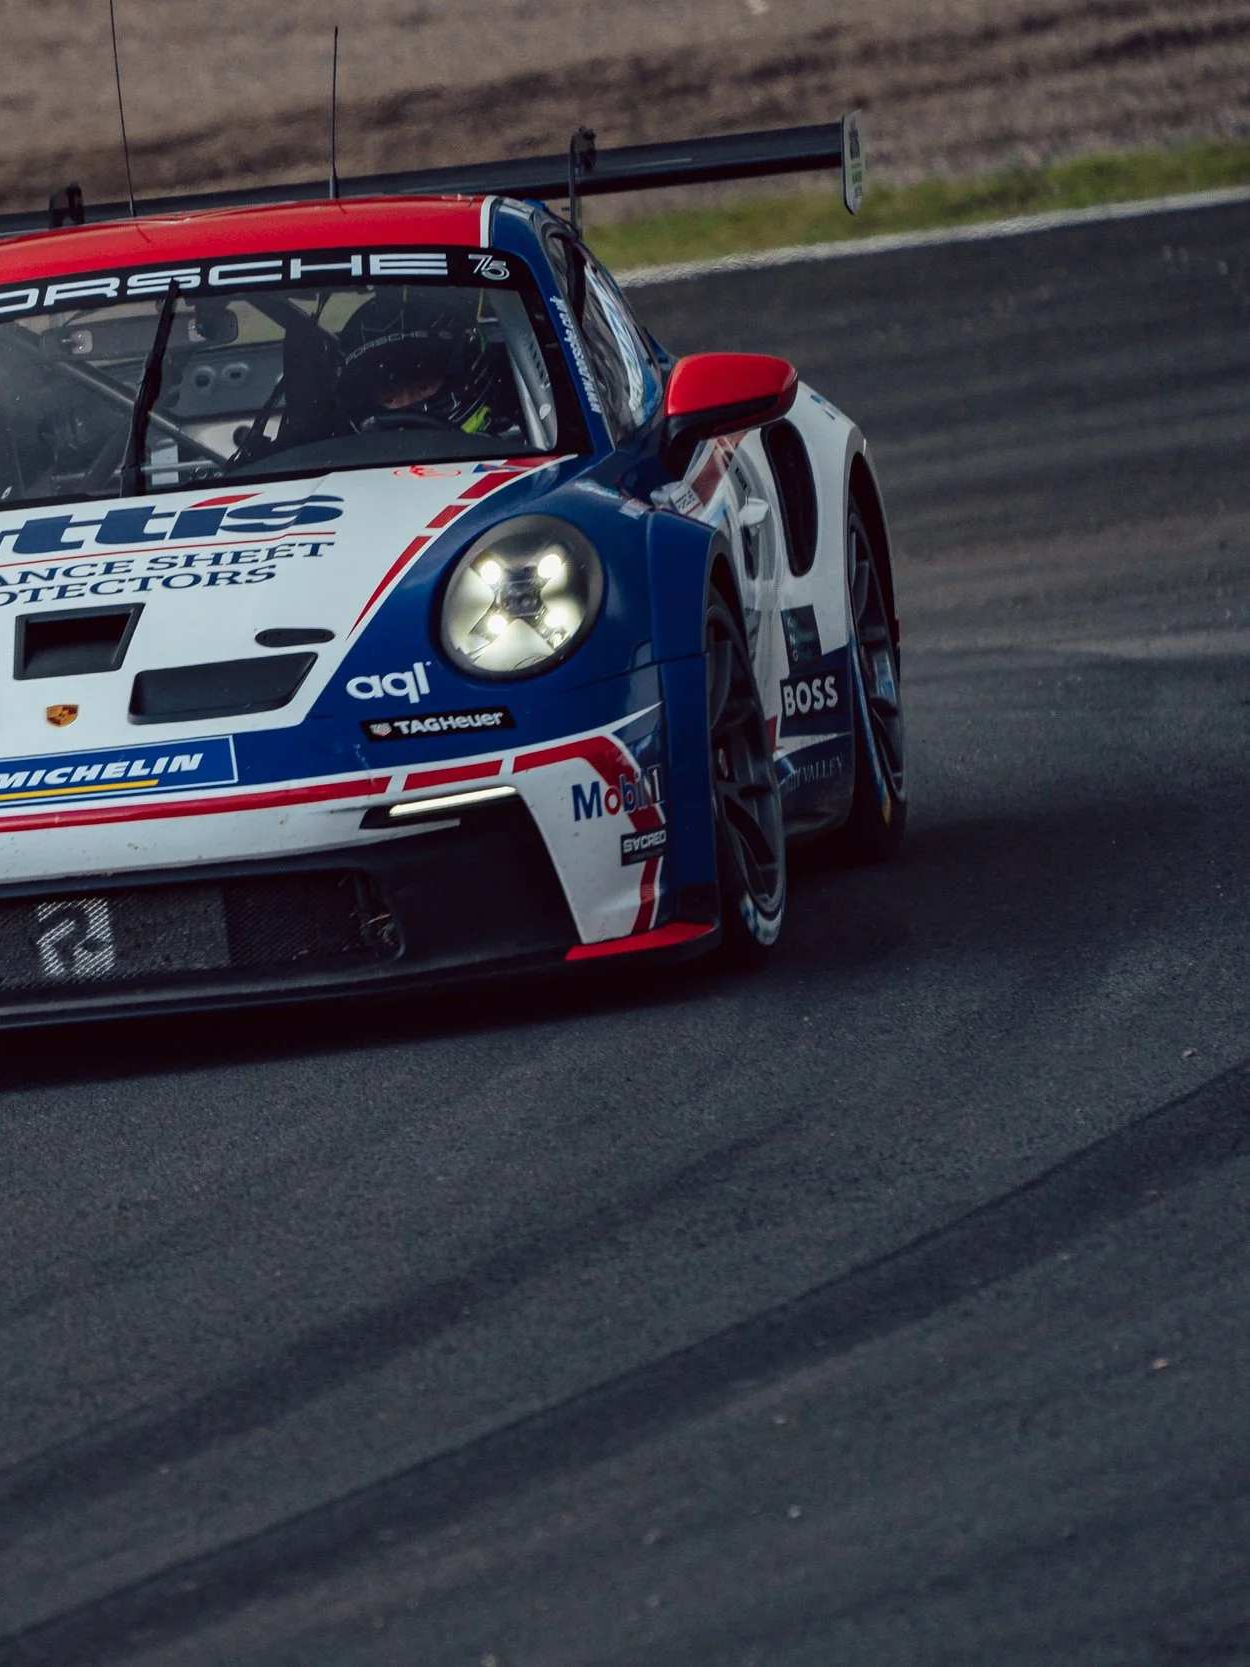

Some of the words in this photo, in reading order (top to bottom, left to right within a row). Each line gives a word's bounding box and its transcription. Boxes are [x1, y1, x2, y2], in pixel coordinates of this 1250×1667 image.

[345, 330, 429, 365] PORSCHE
[146, 541, 335, 572] SHEET
[346, 661, 431, 704] aql
[784, 676, 838, 717] BOSS
